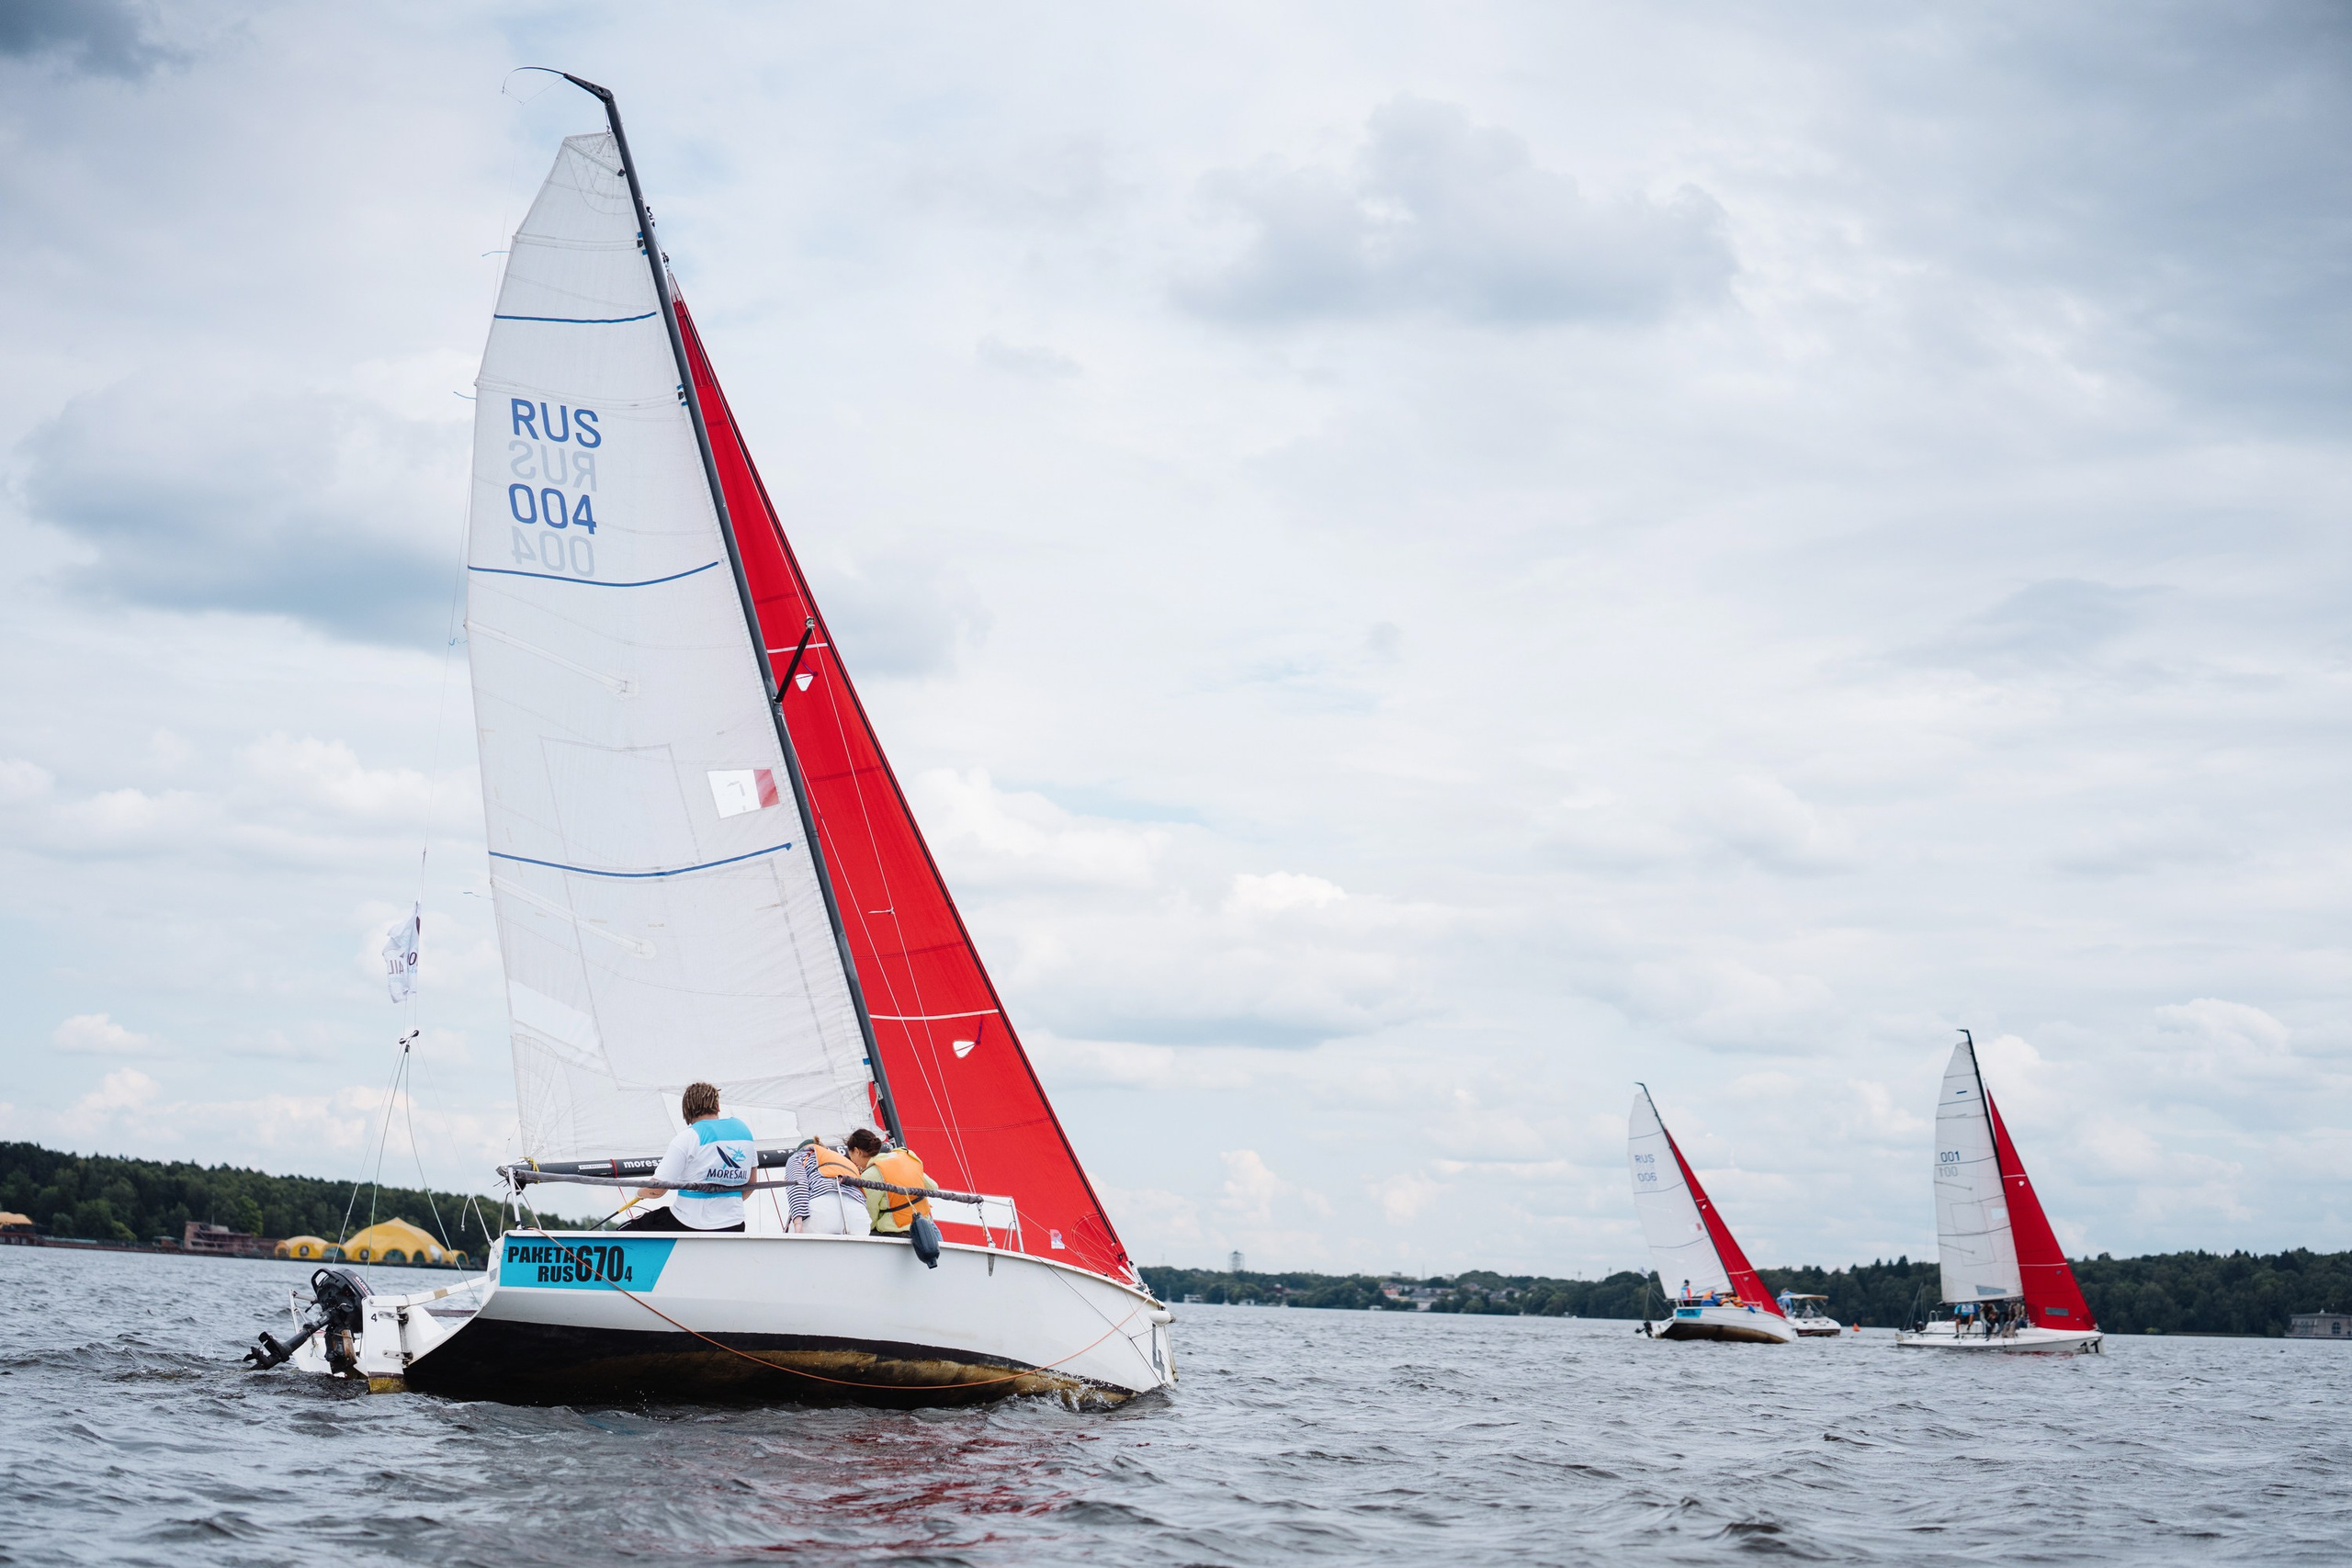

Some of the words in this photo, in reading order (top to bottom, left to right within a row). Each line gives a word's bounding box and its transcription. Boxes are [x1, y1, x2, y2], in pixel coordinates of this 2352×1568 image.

[511, 398, 602, 448] RUS
[508, 483, 597, 535] 004
[1634, 1154, 1655, 1163] RUS
[1940, 1151, 1960, 1162] 001
[707, 1168, 747, 1179] MORESAIL
[537, 1266, 573, 1282] RUS
[575, 1246, 624, 1282] 670
[625, 1266, 632, 1282] 4
[371, 1314, 378, 1322] 4
